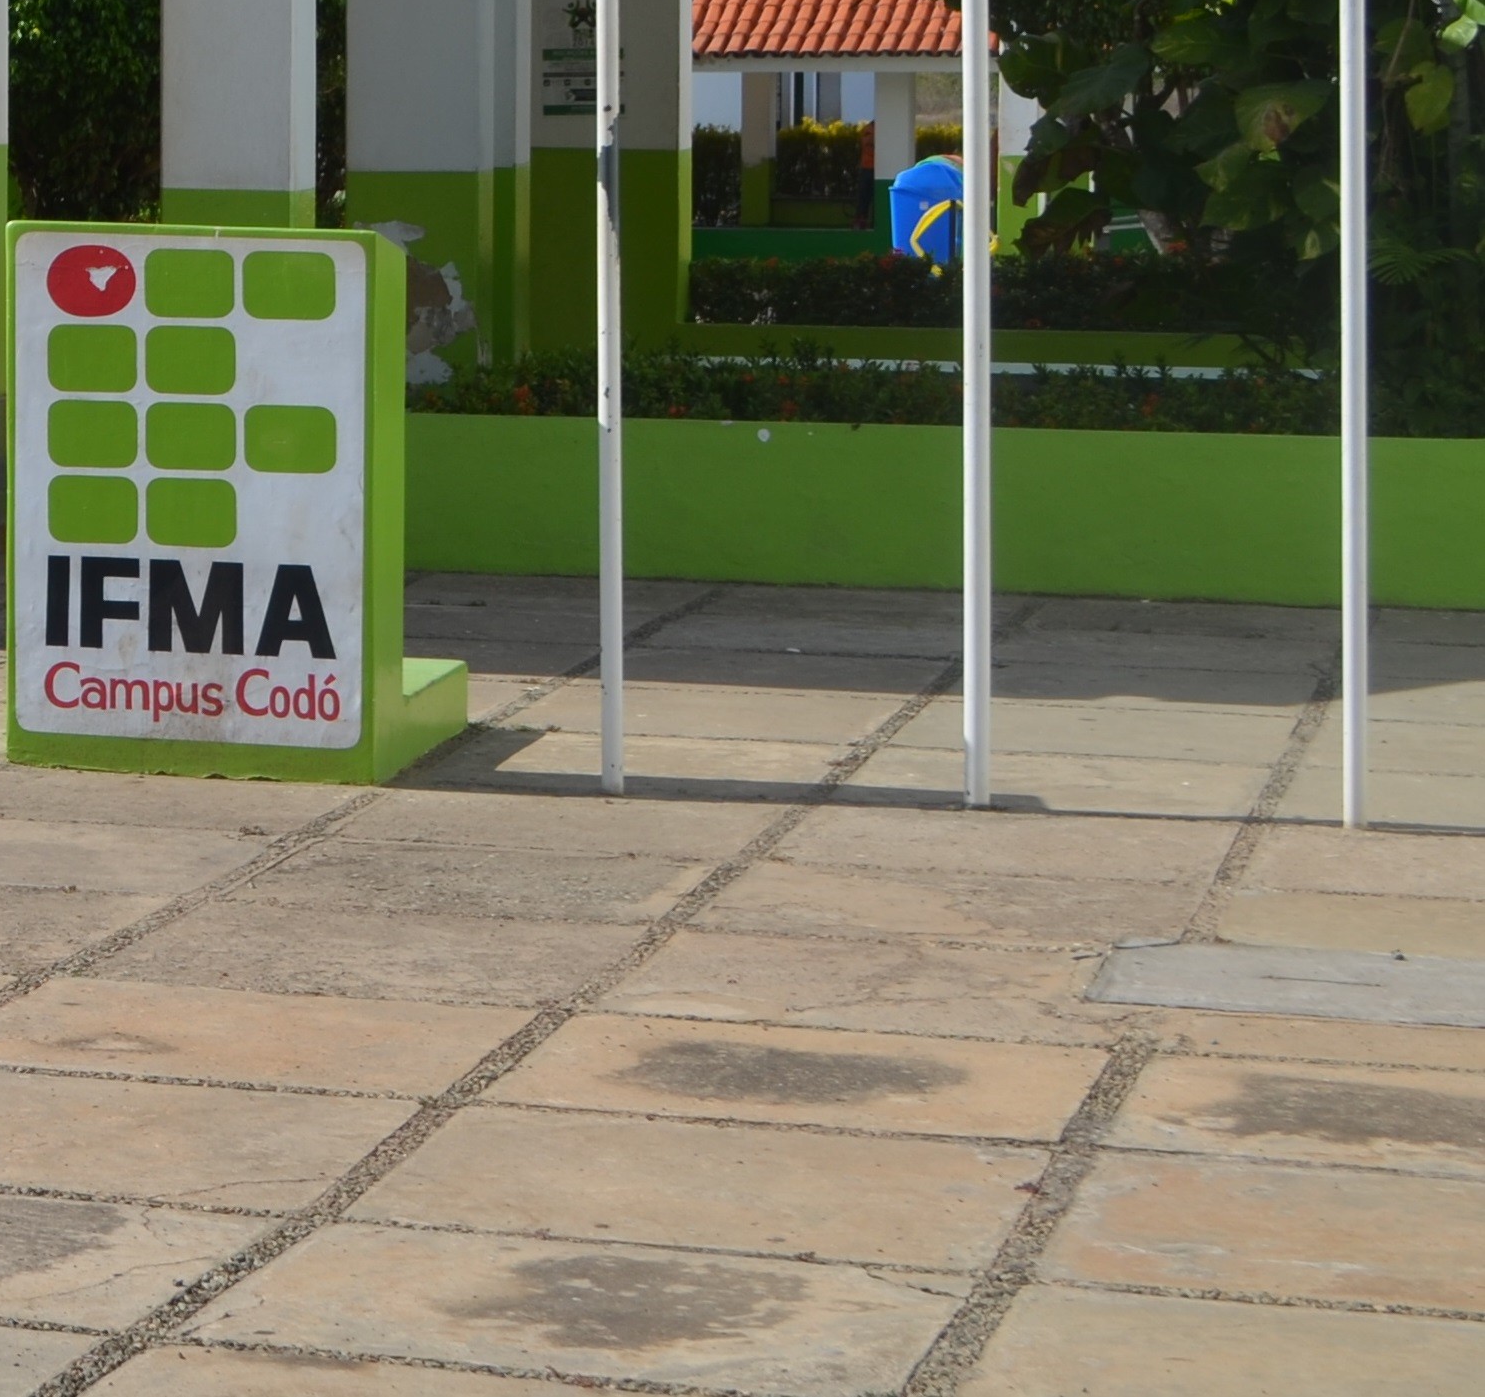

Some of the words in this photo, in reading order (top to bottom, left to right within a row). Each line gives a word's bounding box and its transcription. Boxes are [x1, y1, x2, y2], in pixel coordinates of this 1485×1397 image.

[44, 555, 338, 661] IFMA
[44, 661, 224, 723] Campus
[236, 668, 341, 723] Codó
